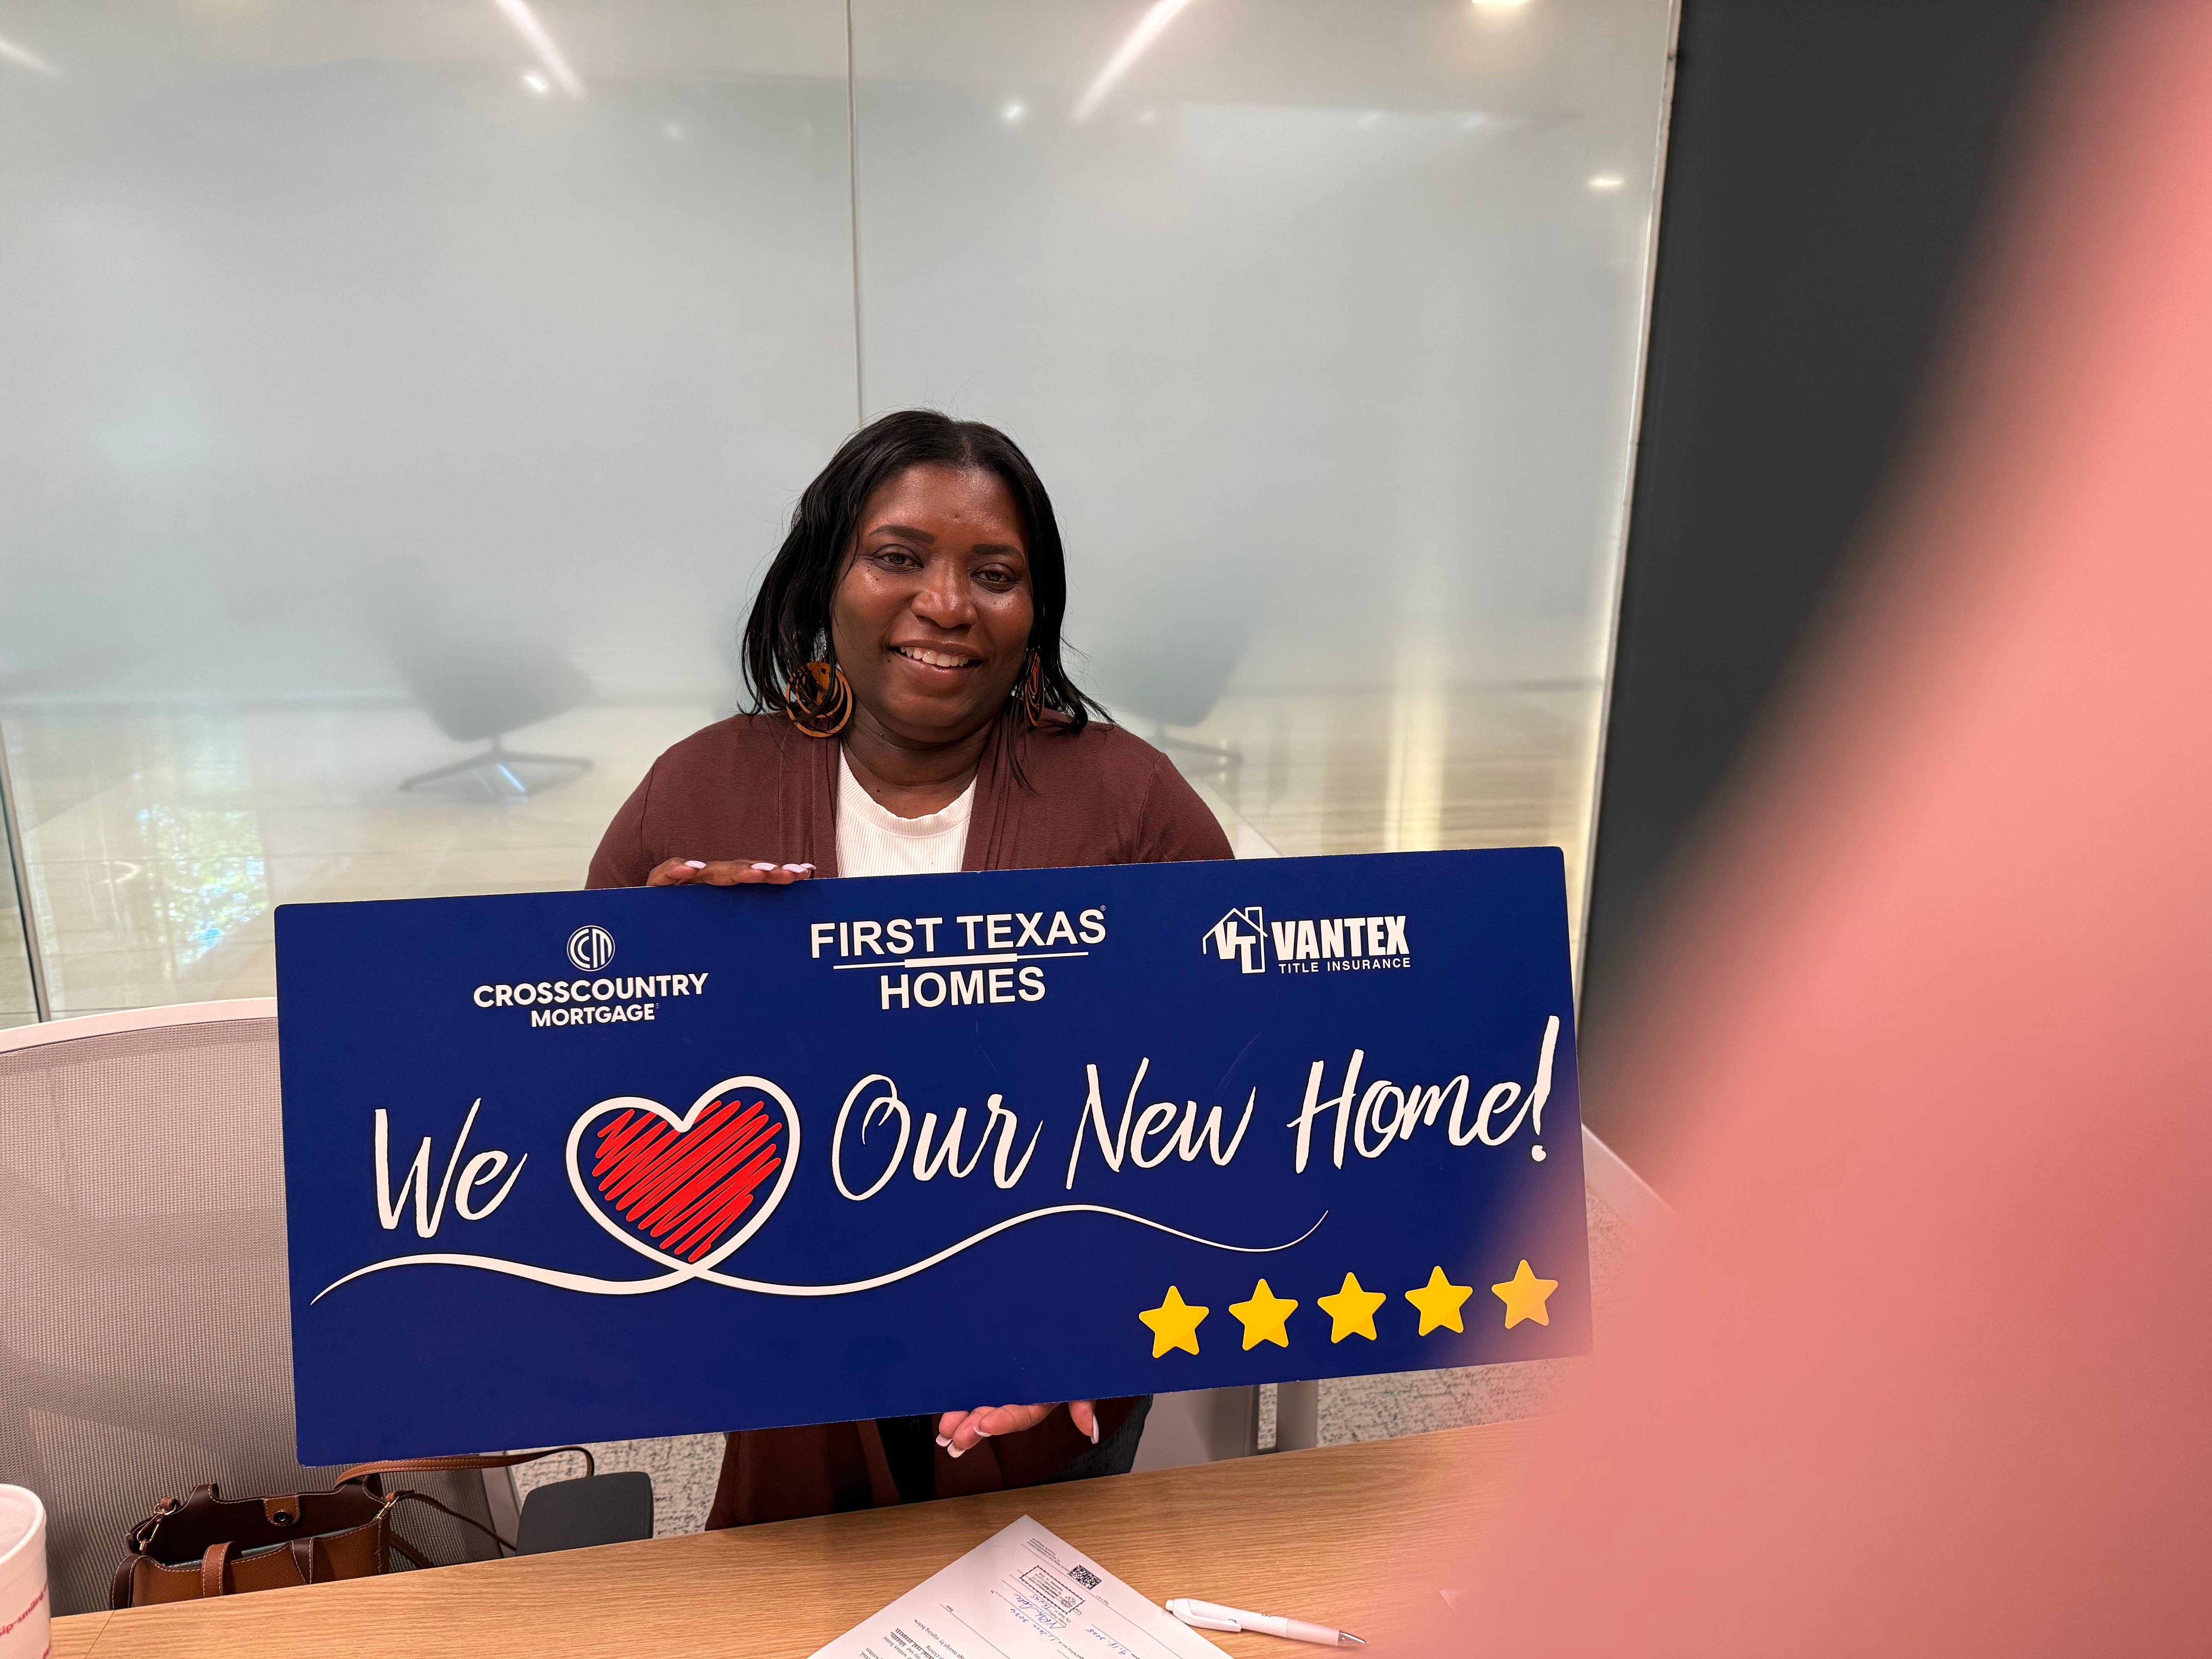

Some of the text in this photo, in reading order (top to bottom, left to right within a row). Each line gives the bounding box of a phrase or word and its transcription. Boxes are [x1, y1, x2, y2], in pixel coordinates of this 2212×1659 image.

[811, 910, 1105, 960] FIRST TEXAS
[1271, 916, 1410, 961] VANTEX
[1278, 957, 1411, 974] TITLE INSURANCE
[474, 973, 708, 1008] CROSSCOUNTRY
[879, 964, 1045, 1009] HOMES
[532, 1003, 654, 1027] MORTGAGE
[375, 1016, 1559, 1238] We Our New Home!
[883, 1636, 895, 1647] home
[893, 1645, 908, 1658] written
